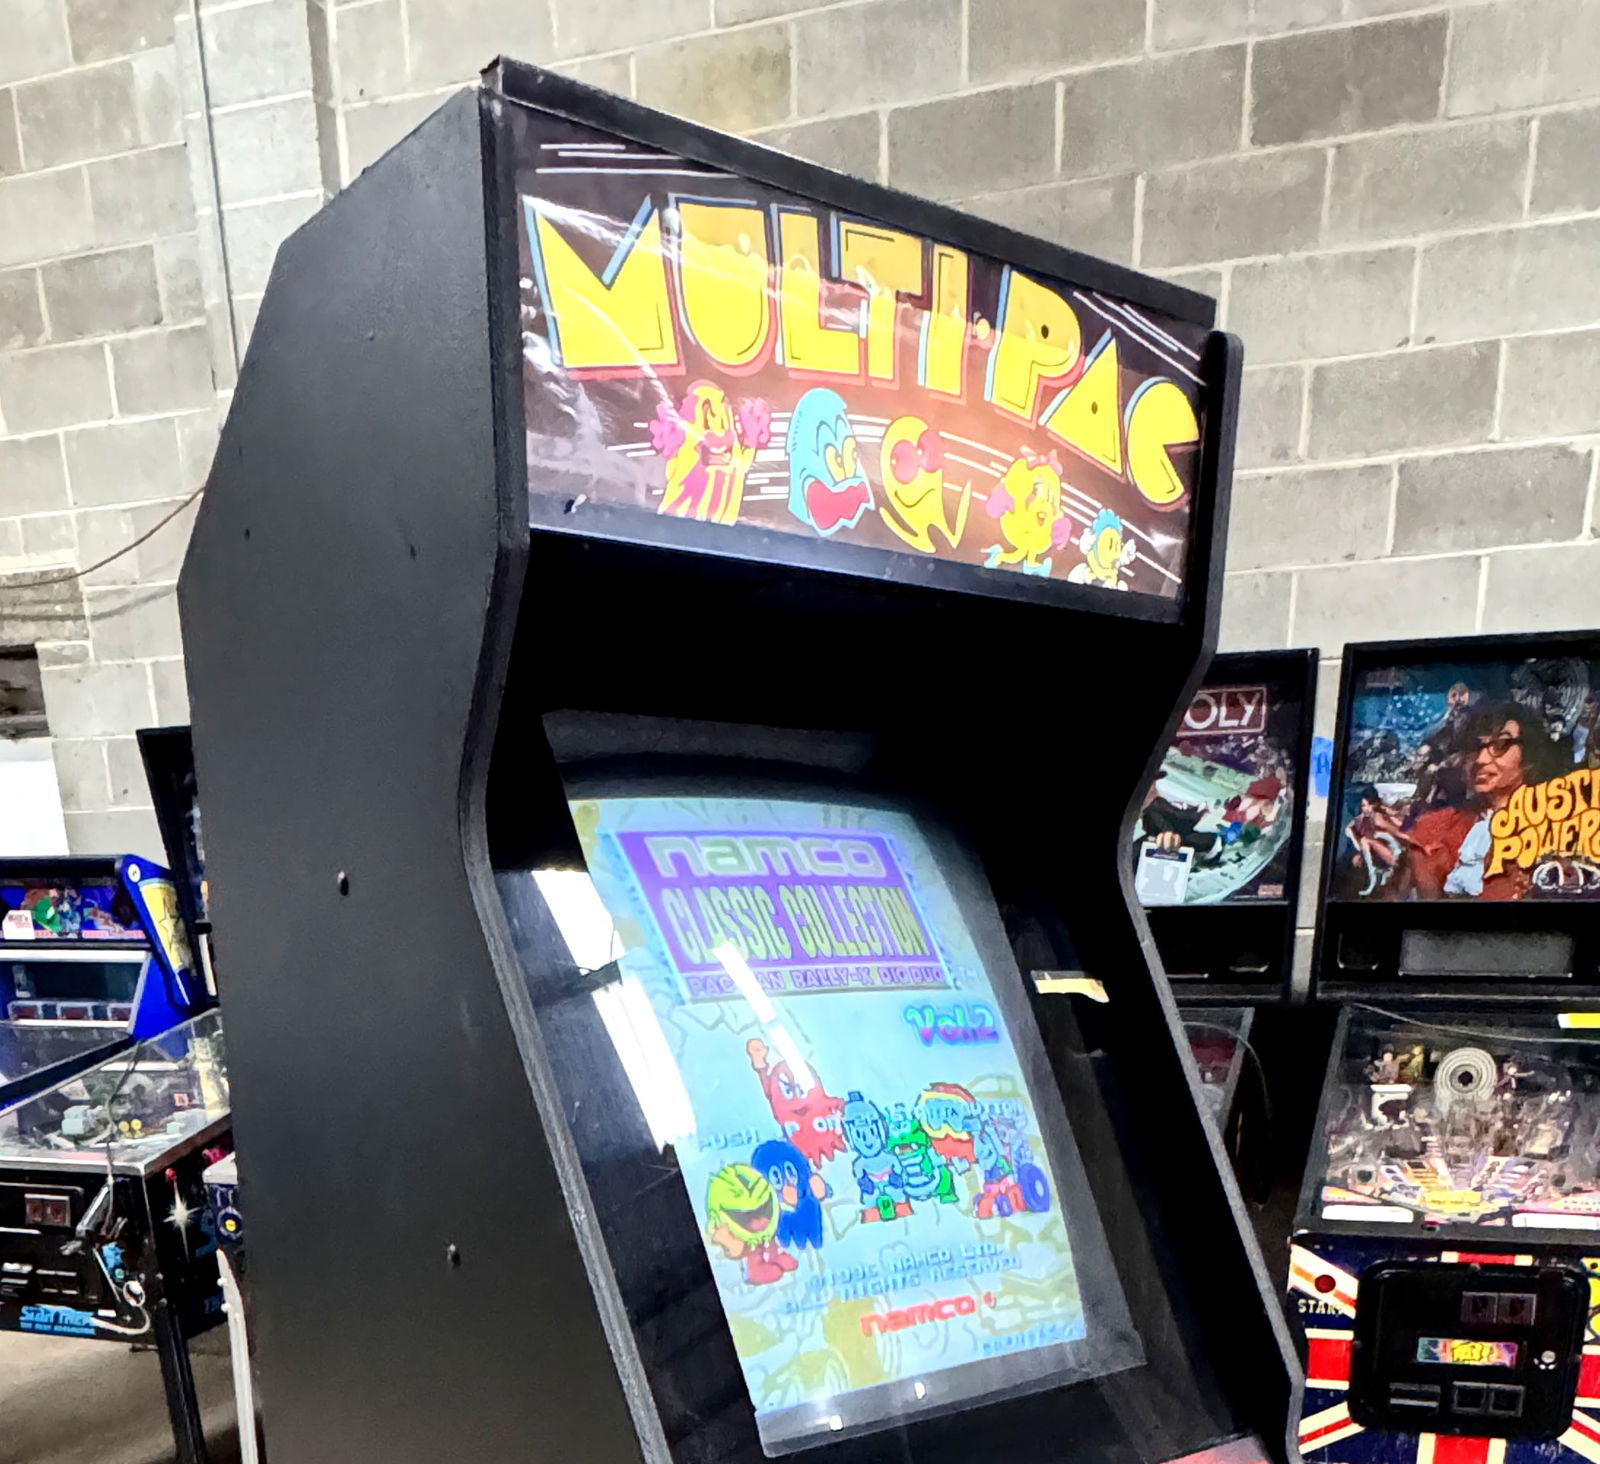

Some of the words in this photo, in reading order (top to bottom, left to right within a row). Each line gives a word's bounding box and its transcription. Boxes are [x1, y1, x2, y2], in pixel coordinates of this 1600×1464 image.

[643, 835, 888, 878] namco
[660, 885, 794, 964] CLASSIC
[777, 885, 933, 959] COLLECTION
[686, 971, 786, 996] PACAN
[790, 966, 875, 988] RALLY-X
[860, 1295, 976, 1337] namco
